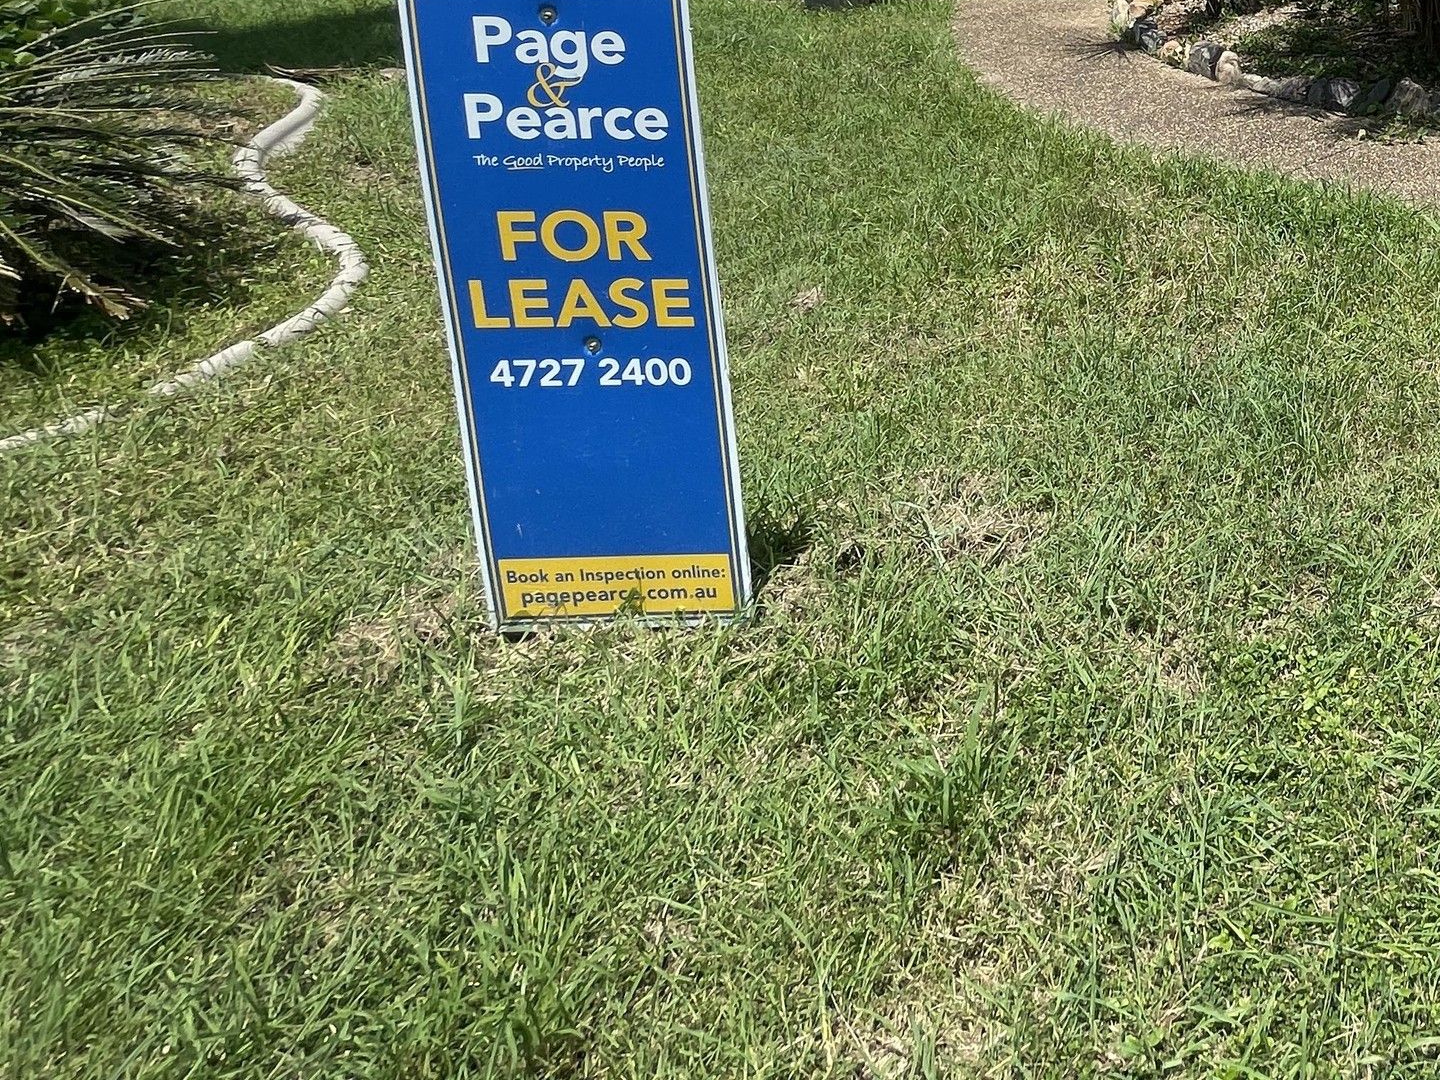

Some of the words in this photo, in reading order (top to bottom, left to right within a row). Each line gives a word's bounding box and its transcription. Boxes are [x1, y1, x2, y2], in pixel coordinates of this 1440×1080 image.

[471, 15, 627, 79] Page
[526, 62, 586, 108] &
[463, 93, 669, 141] Pearce
[473, 153, 499, 167] The
[502, 153, 545, 170] Good
[546, 153, 614, 172] Property
[616, 154, 665, 171] People
[496, 210, 652, 262] FOR
[467, 278, 696, 329] LEASE
[490, 359, 585, 388] 4727
[598, 358, 692, 386] 2400
[506, 569, 549, 584] Book
[555, 570, 574, 582] an
[580, 567, 666, 584] Inspection
[671, 565, 726, 579] online:
